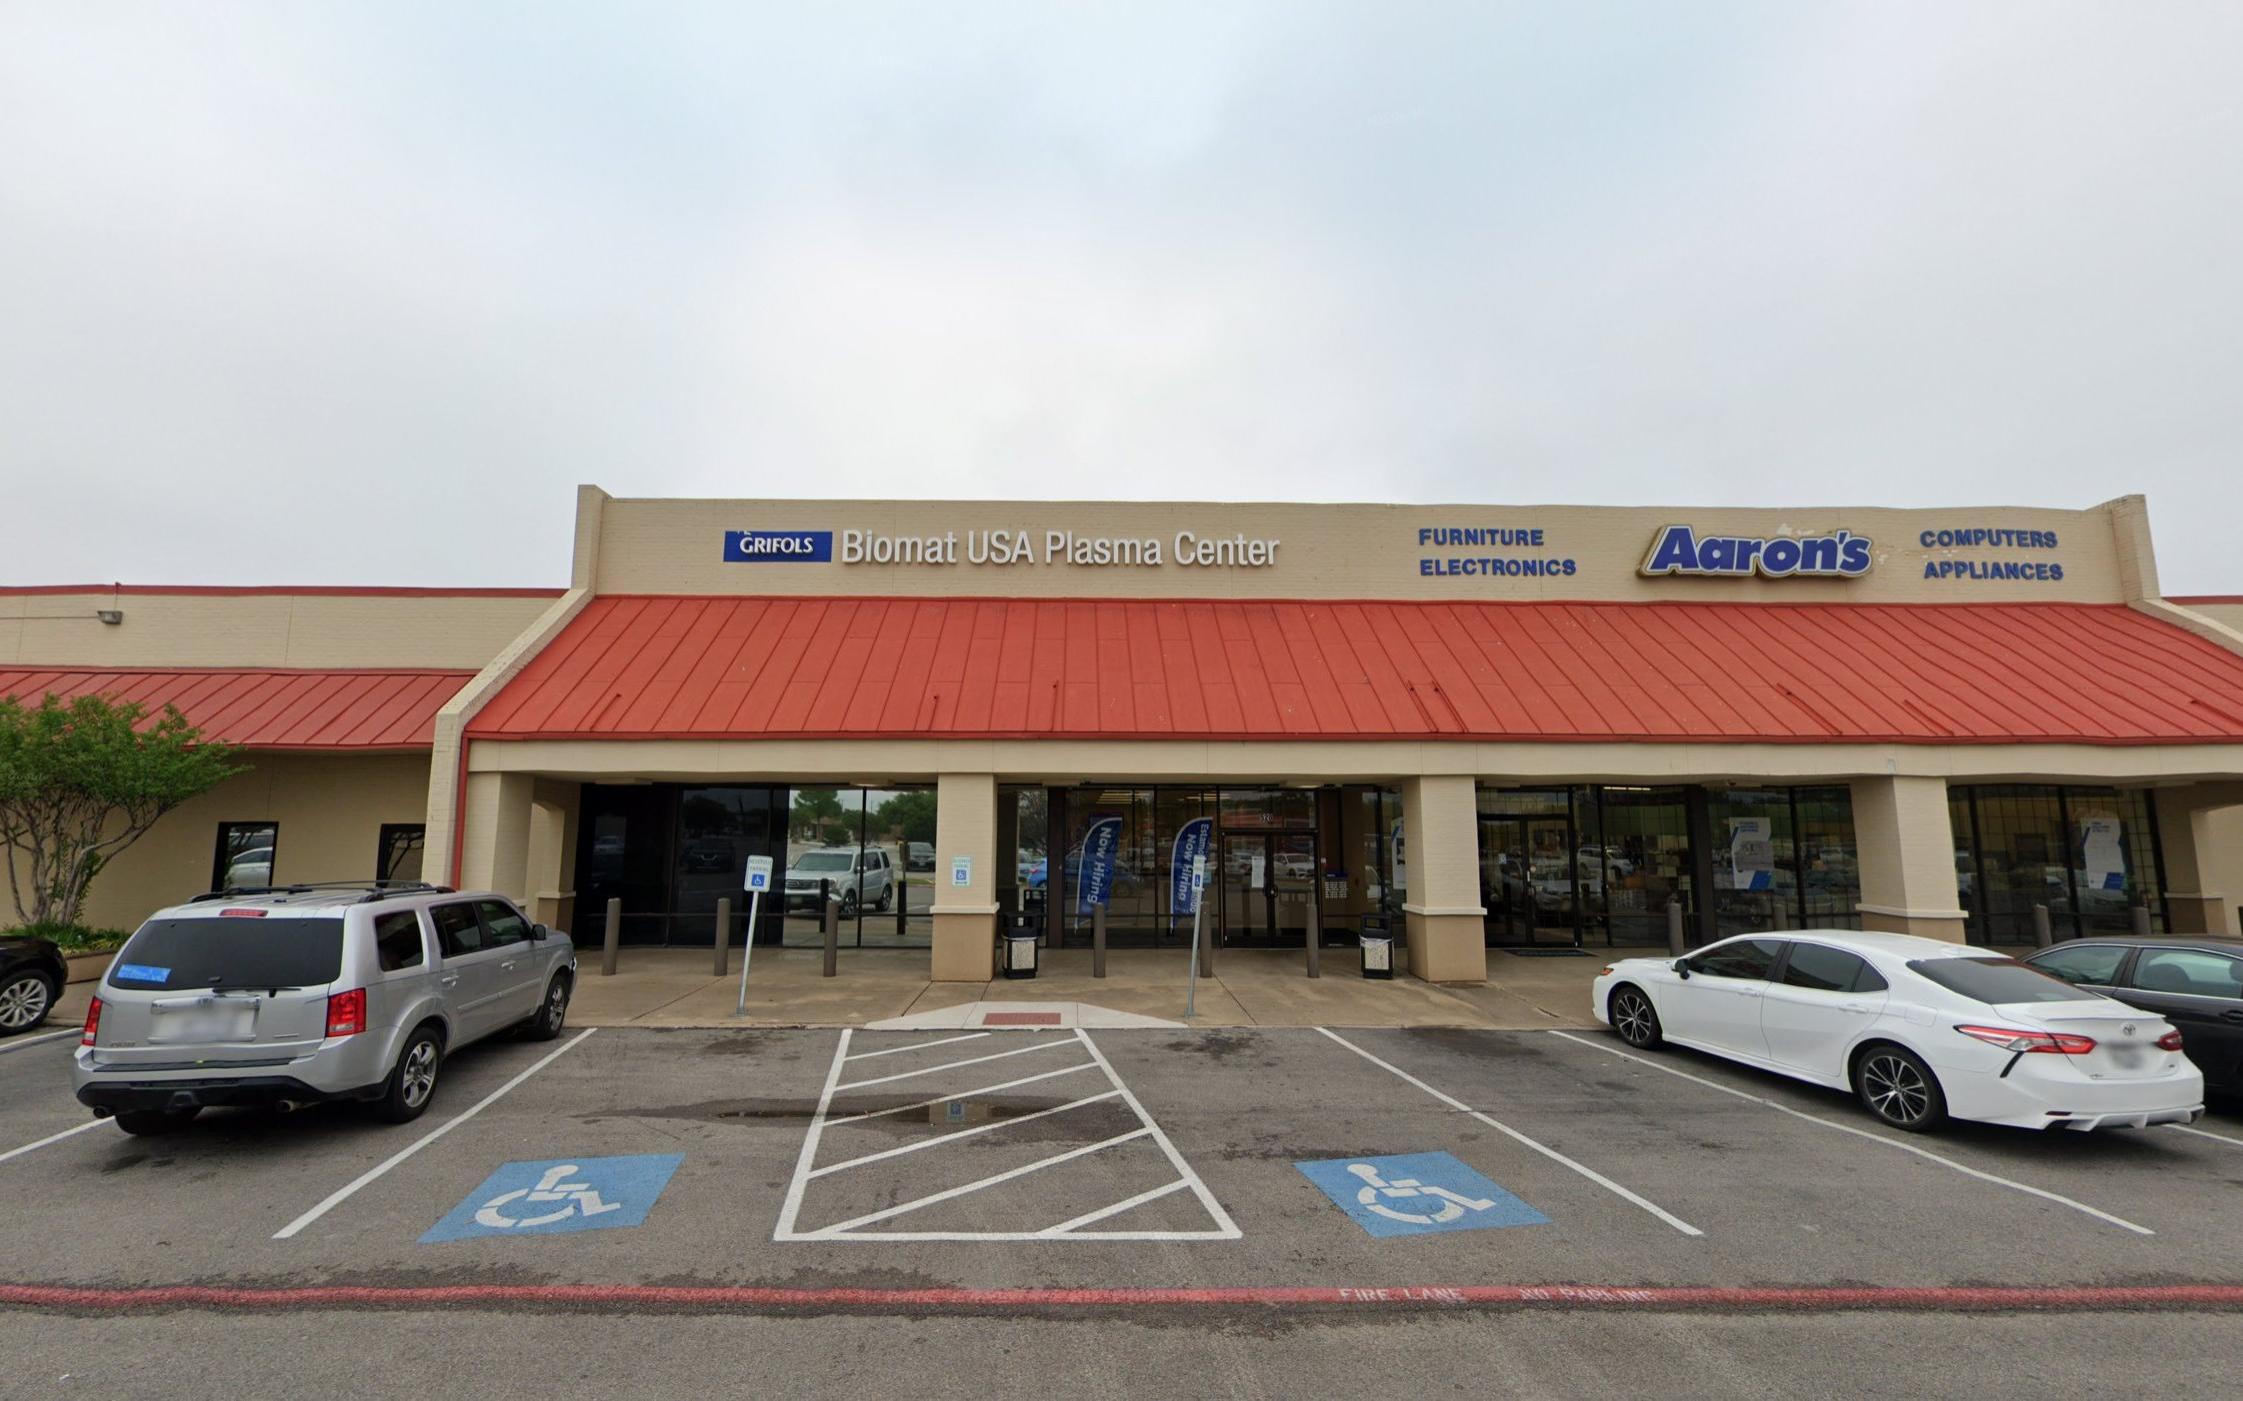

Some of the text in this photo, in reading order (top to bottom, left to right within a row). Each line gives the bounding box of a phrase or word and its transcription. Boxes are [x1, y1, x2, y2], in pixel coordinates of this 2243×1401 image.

[739, 537, 814, 554] GRIFOLS
[1418, 528, 1544, 547] FURNITURE
[1920, 530, 2058, 549] COMPUTERS
[841, 529, 1281, 567] Biomat USA Plasma Center
[1644, 525, 1873, 576] Aaron's
[1419, 557, 1577, 577] ELECTRONICS
[1923, 559, 2064, 580] APPLIANCES
[1087, 827, 1112, 904] Now Hiring
[1178, 833, 1197, 901] Now Hiring
[1340, 1288, 1388, 1301] FIRE
[1403, 1288, 1460, 1301] LANE
